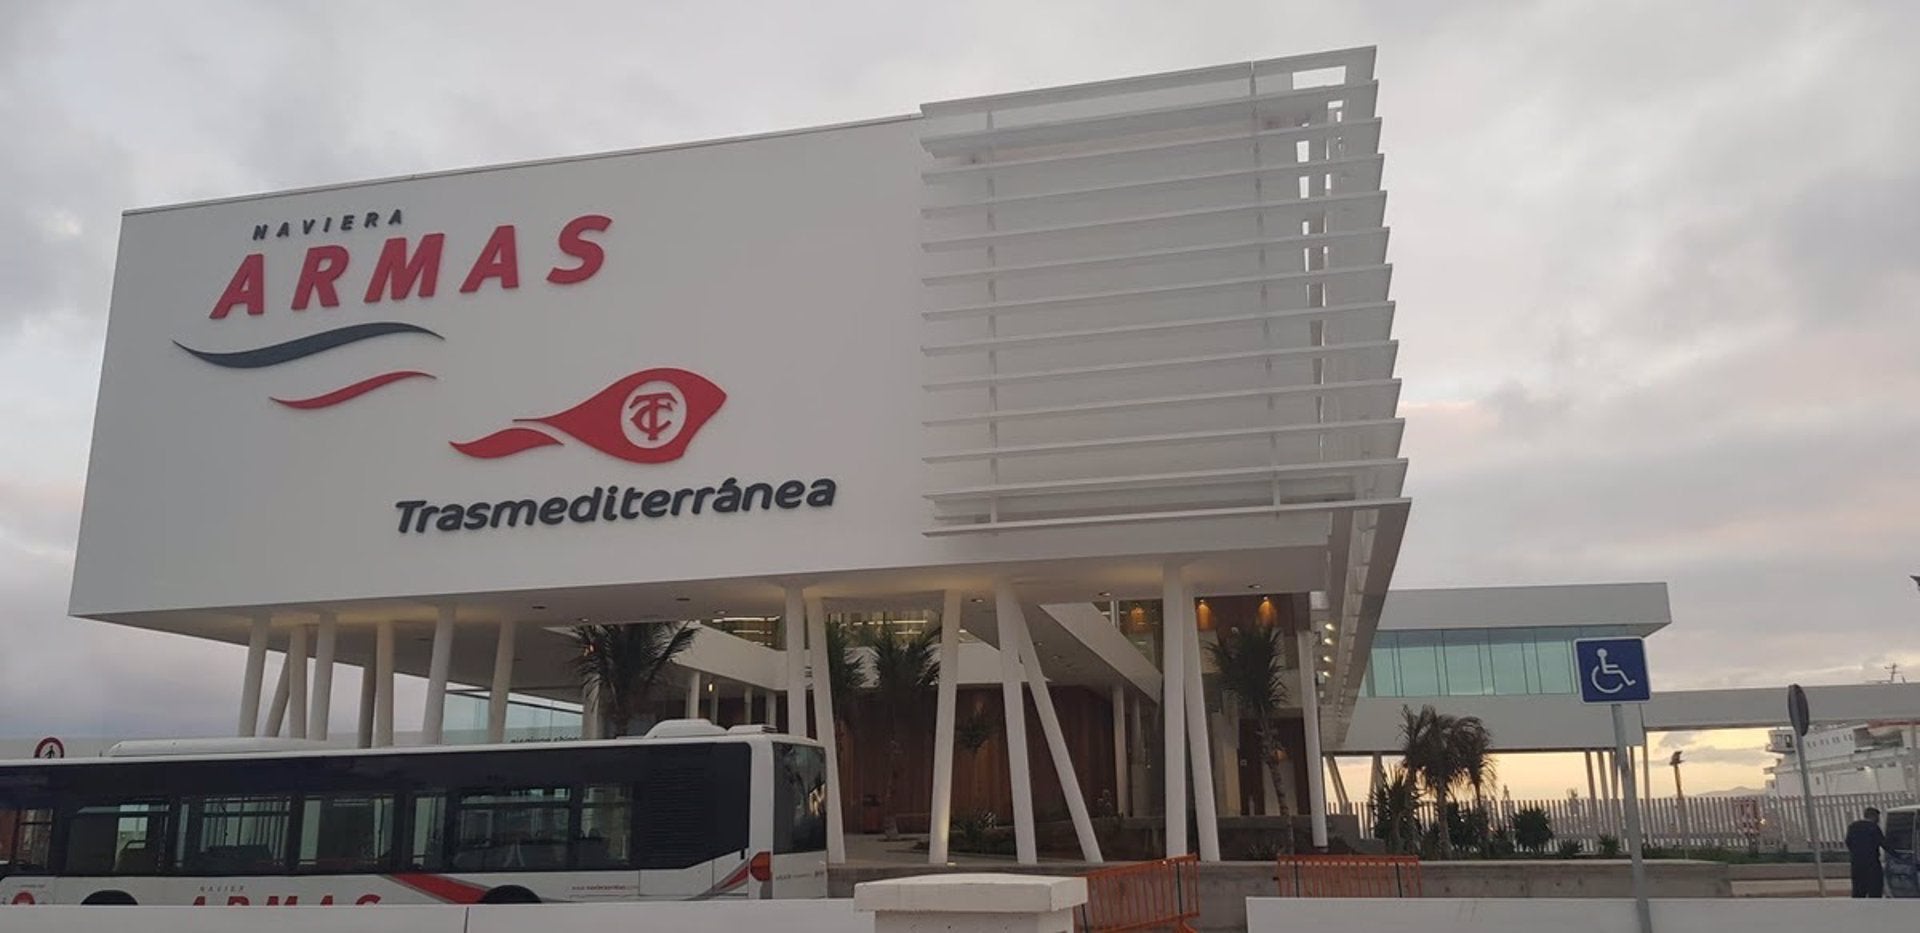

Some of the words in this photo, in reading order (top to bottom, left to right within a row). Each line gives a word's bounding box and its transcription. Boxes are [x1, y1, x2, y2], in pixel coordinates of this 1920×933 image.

[252, 209, 403, 241] NAVIERA
[209, 214, 612, 319] ARMAS
[395, 477, 837, 533] Trasmediterránea
